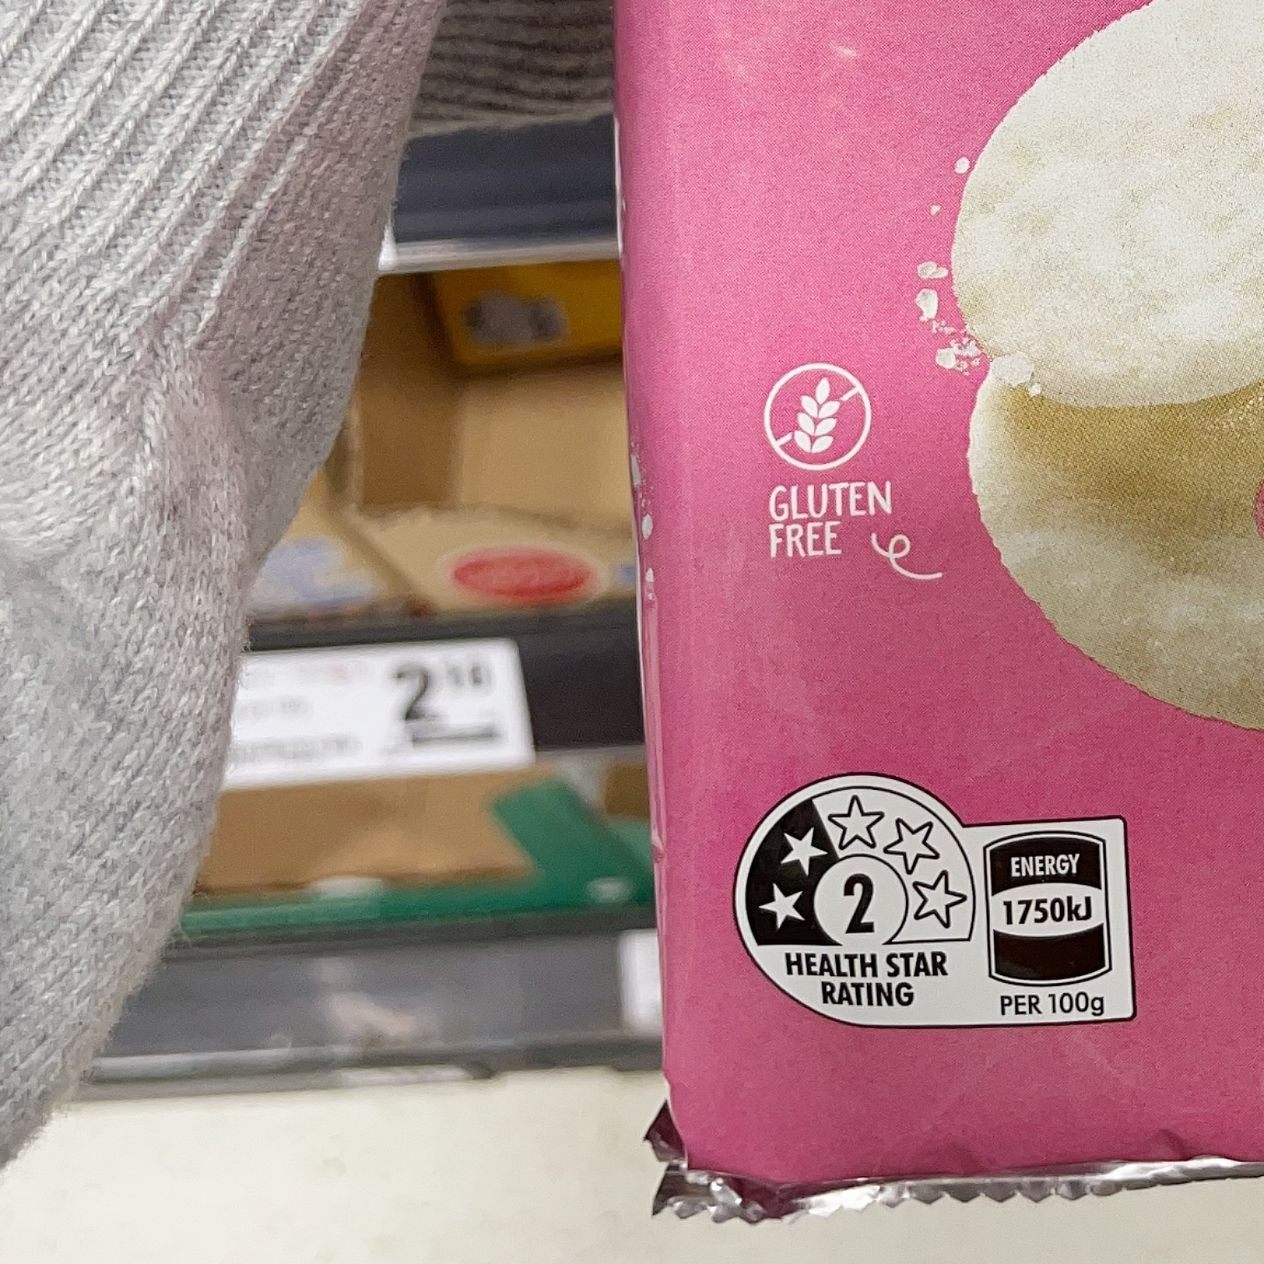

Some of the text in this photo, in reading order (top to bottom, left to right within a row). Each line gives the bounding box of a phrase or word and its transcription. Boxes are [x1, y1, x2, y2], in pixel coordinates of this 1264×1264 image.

[768, 480, 893, 522] GLUTEN
[768, 520, 842, 559] FREE
[1010, 853, 1081, 878] ENERGY
[842, 872, 875, 935] 2
[1002, 896, 1094, 926] 1750kJ
[784, 951, 949, 979] HEALTH STAR
[821, 981, 915, 1007] RATING
[1000, 991, 1105, 1018] PER 100g
